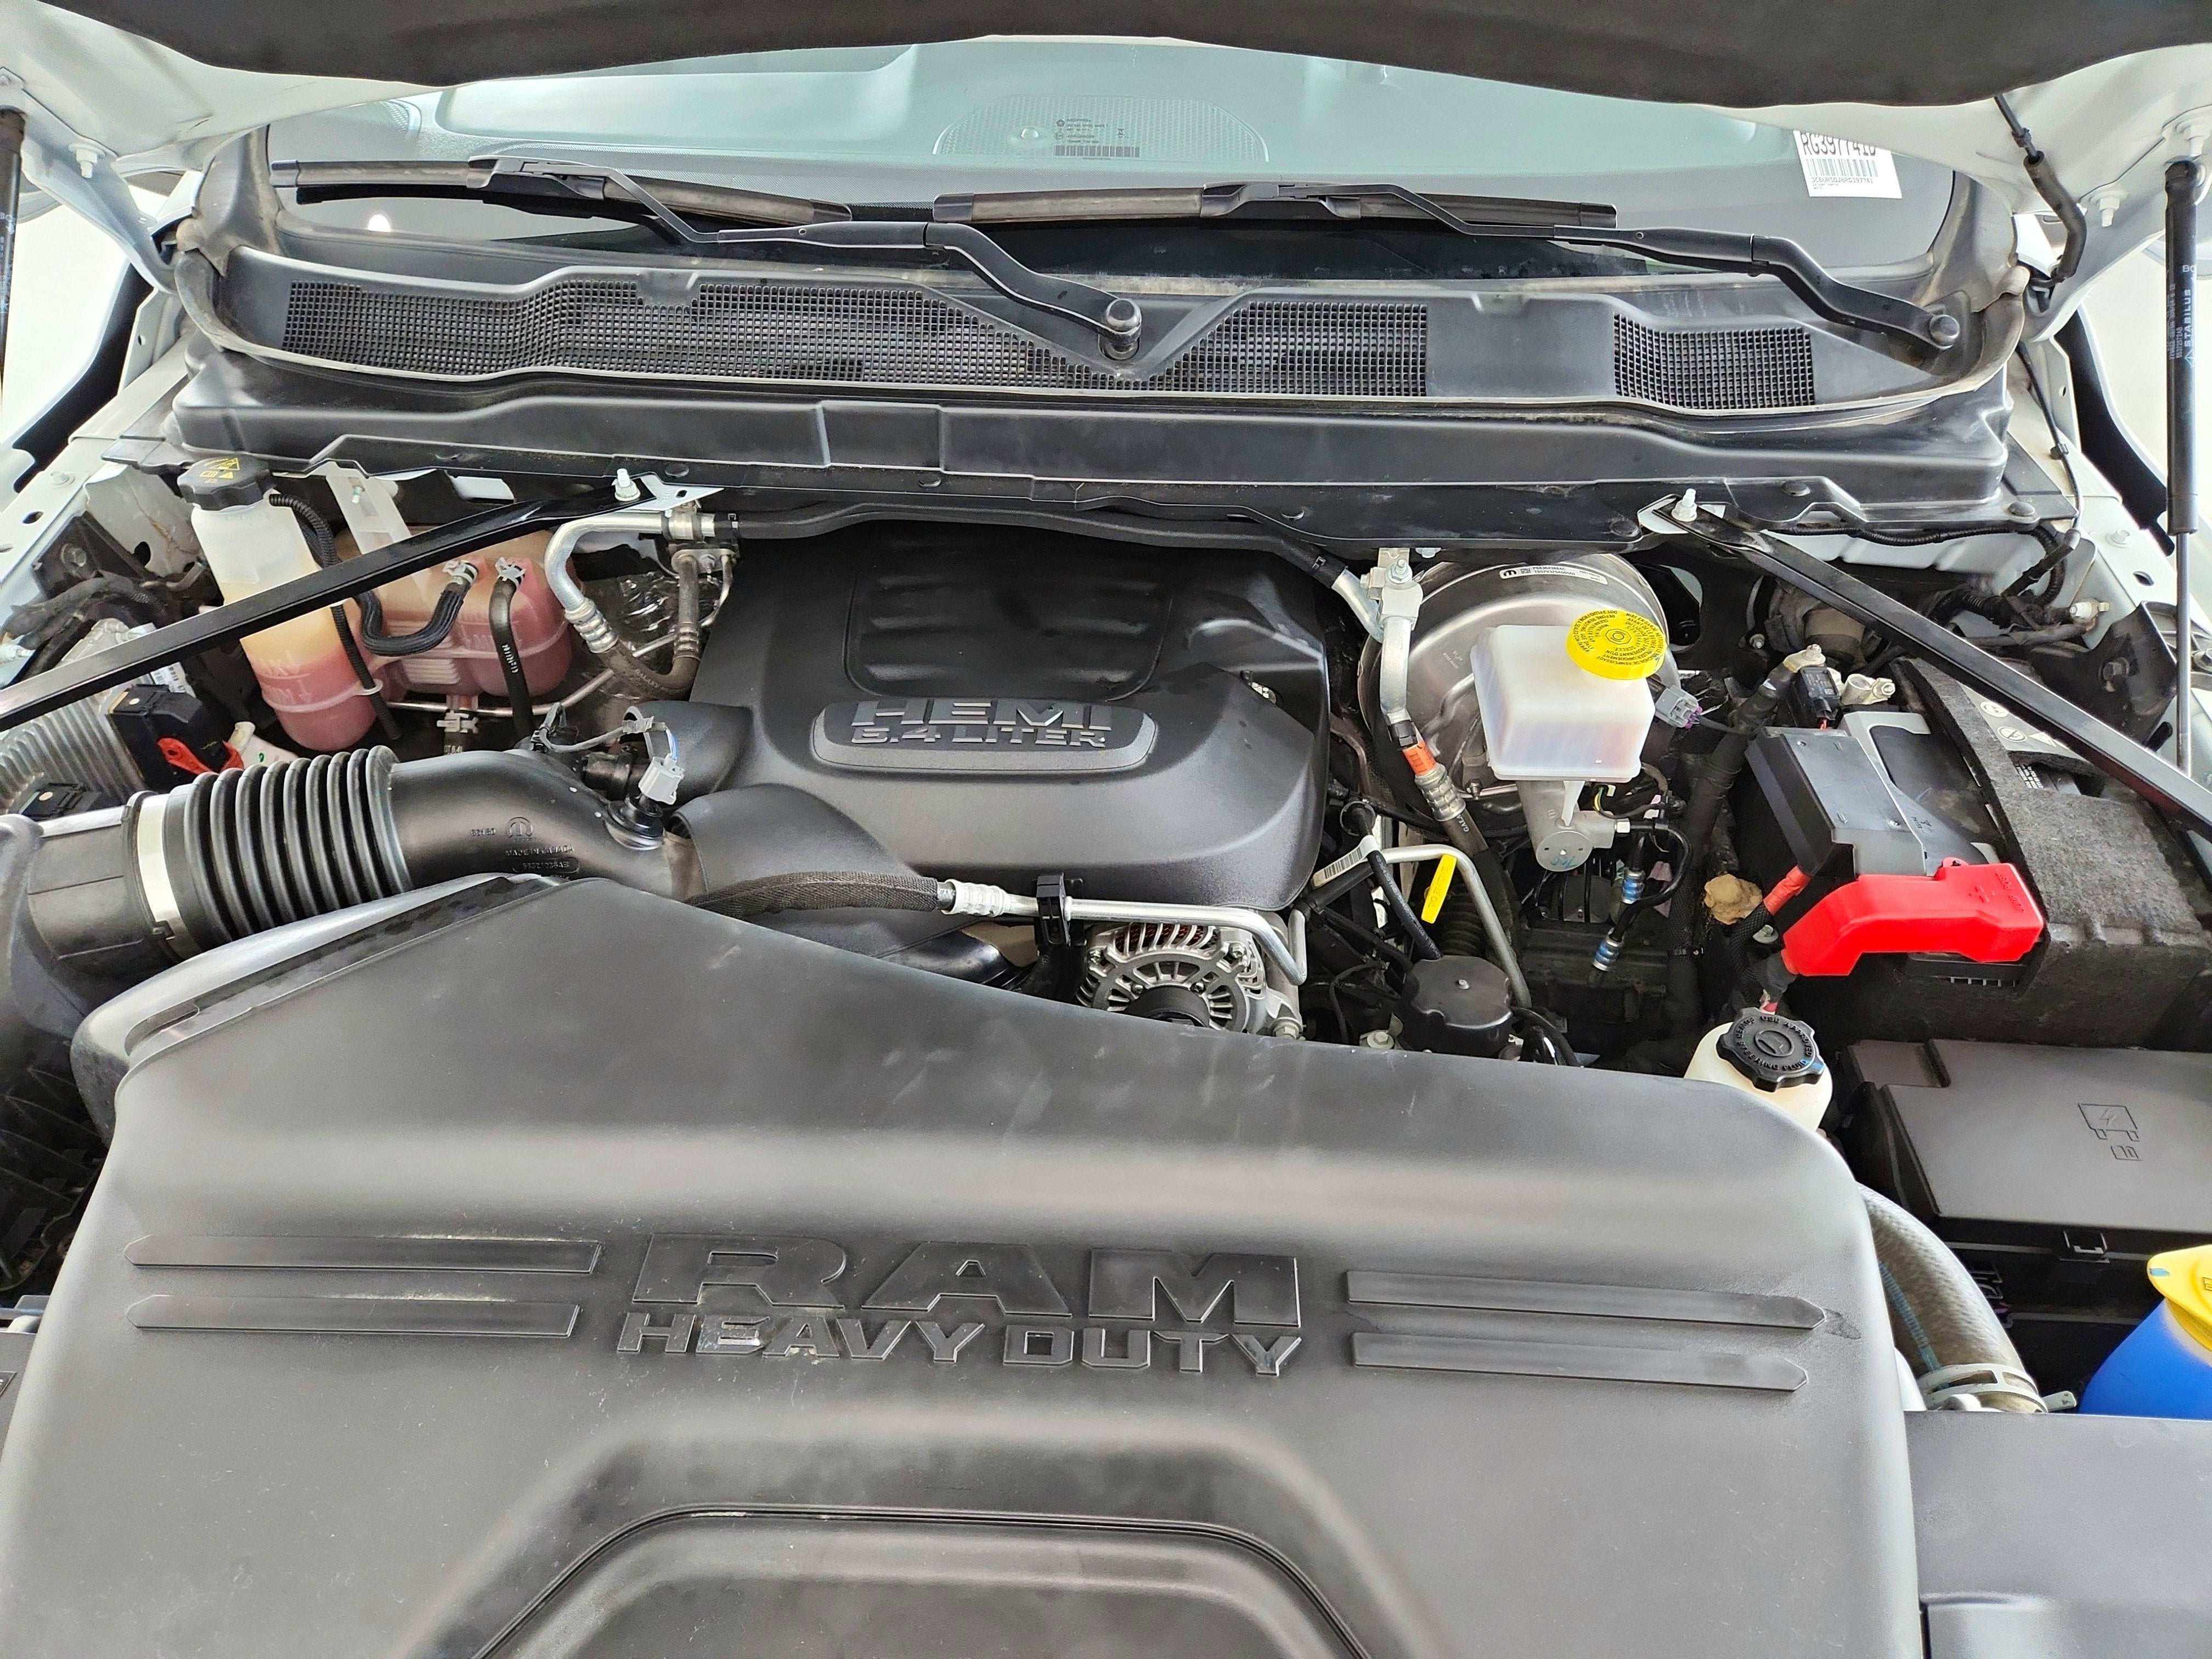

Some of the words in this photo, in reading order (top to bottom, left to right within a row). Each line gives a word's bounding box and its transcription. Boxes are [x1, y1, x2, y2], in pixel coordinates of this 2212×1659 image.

[851, 699, 1113, 731] HEMI
[851, 725, 942, 743] 6.4
[951, 725, 1106, 748] LITER
[1759, 1015, 1781, 1024] USE
[1783, 1021, 1814, 1057] APPROVED
[1737, 1039, 1780, 1071] STEERING
[1782, 1058, 1809, 1071] FLUID
[632, 1232, 1302, 1328] RAM
[617, 1312, 986, 1363] HEAVY
[1003, 1324, 1302, 1377] DUTY
